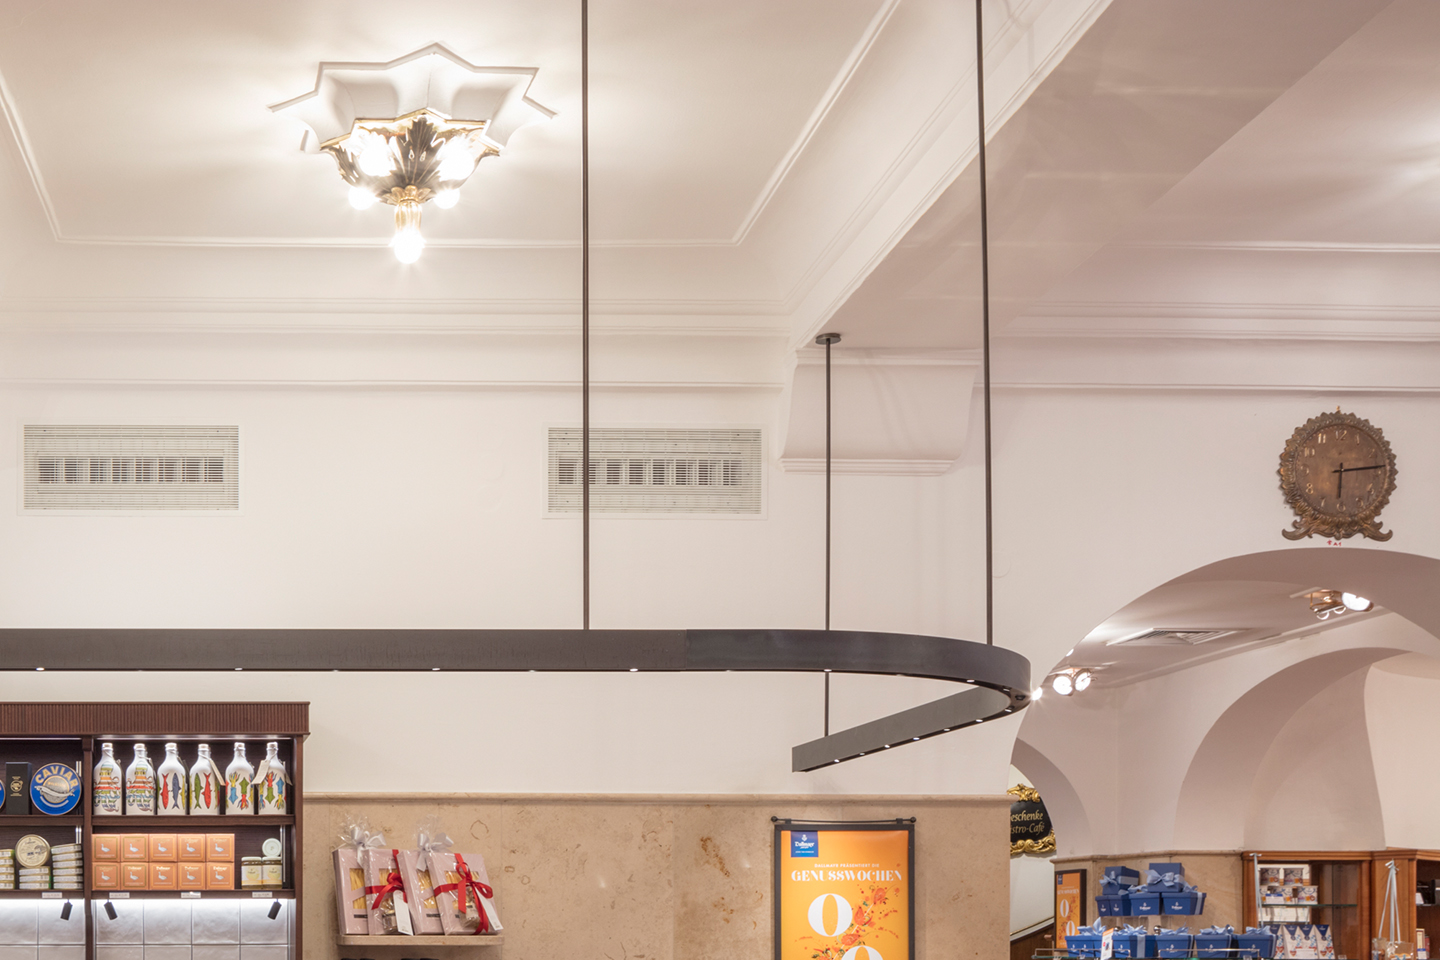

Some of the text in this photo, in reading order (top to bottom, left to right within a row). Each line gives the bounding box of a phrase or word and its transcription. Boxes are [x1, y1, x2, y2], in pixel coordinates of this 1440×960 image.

[1317, 433, 1326, 444] 11
[1335, 430, 1347, 441] 12
[1305, 482, 1314, 495] 8
[35, 765, 79, 788] CAVIAR
[1011, 810, 1044, 822] eschenke
[1011, 821, 1045, 836] stro-Café
[791, 870, 902, 882] GENUSSWOCHEN
